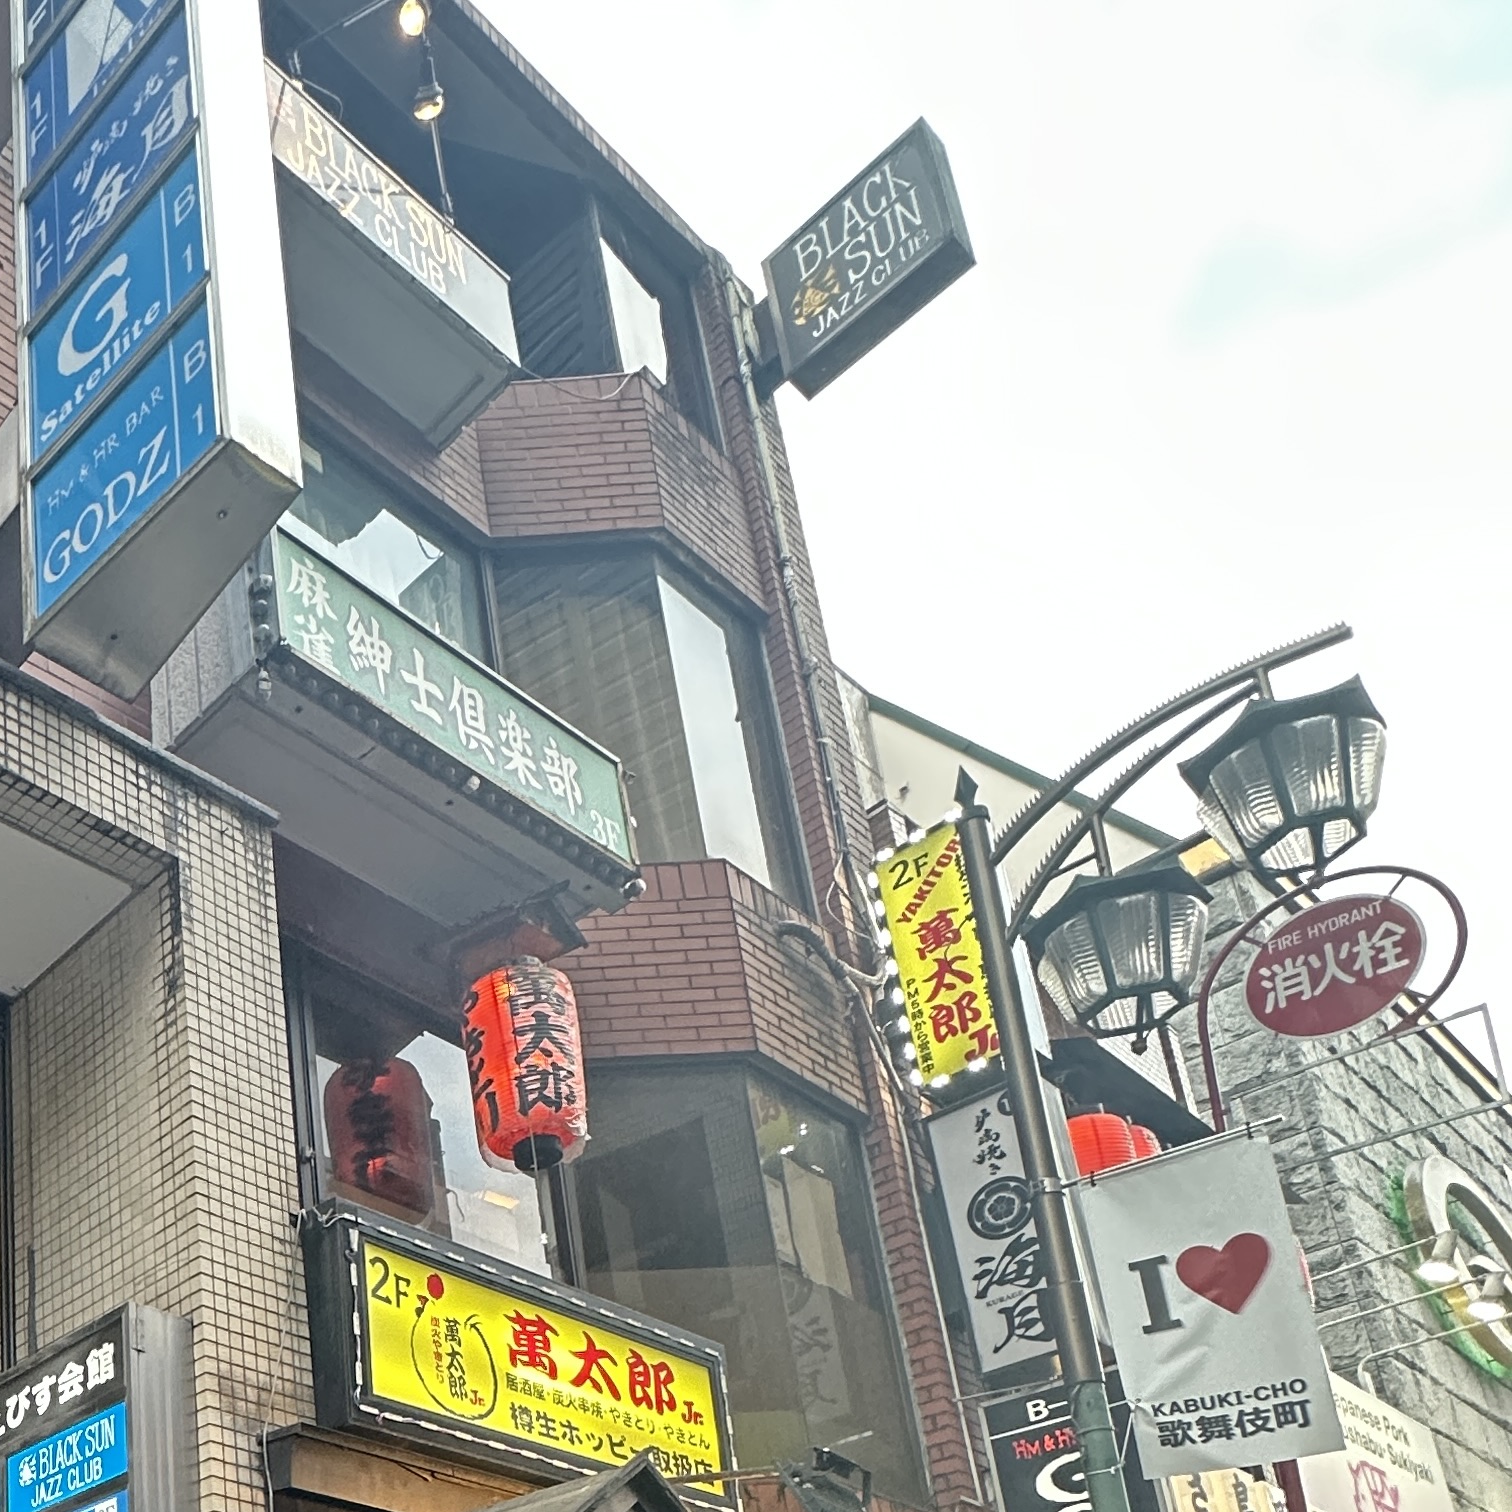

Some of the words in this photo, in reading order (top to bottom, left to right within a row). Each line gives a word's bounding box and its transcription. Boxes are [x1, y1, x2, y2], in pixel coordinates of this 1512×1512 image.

[287, 143, 363, 226] JAZZ
[375, 213, 447, 294] CLUB
[300, 102, 405, 230] BLACK
[405, 199, 466, 285] SUN
[793, 161, 911, 282] BLACK
[844, 186, 922, 284] SUN
[58, 253, 131, 377] G
[812, 282, 867, 337] JAZZ
[871, 228, 930, 287] CLUB
[40, 300, 161, 442] Satellite
[93, 434, 119, 469] HR
[125, 386, 164, 439] BAR
[43, 425, 170, 583] GODZ
[287, 557, 341, 677] 麻雀
[590, 810, 621, 852] 3F
[889, 852, 930, 891] 2F
[896, 832, 961, 924] YAKITOR
[1259, 921, 1410, 1014] 消火栓
[1268, 930, 1303, 955] FIRE
[1307, 900, 1384, 939] HYDRANT
[911, 908, 982, 1044] 萬太郎
[369, 1256, 411, 1308] 2F
[1128, 1255, 1182, 1335] I
[443, 1316, 469, 1401] 萬太郎
[503, 1309, 677, 1415] 萬太郎
[1151, 1378, 1308, 1418] KABUKI-CHO
[38, 1426, 84, 1480] BLACK
[85, 1414, 116, 1453] SUN
[1013, 1439, 1040, 1460] HM
[1157, 1398, 1312, 1448] 歌舞伎町
[1382, 1415, 1410, 1447] Pork
[31, 1473, 63, 1508] JAZZ
[67, 1456, 103, 1490] CLUB
